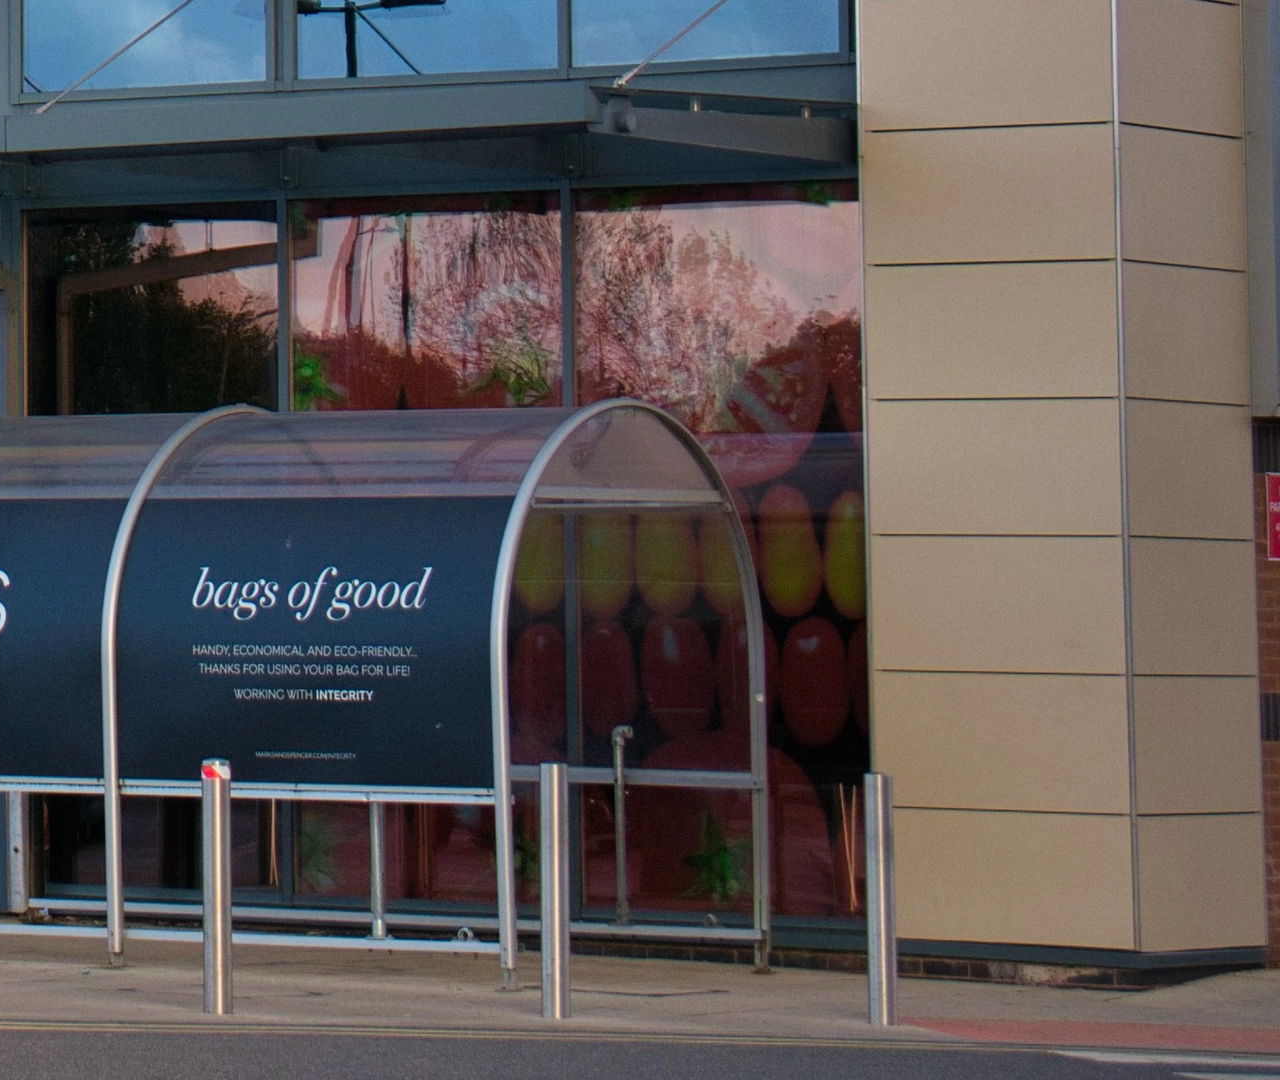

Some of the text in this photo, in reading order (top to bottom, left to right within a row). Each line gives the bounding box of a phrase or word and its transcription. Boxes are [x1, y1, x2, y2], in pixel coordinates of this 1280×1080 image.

[192, 566, 433, 620] bags of good
[192, 645, 231, 658] HANDY,
[233, 645, 304, 657] ECONOMICAL
[307, 645, 331, 657] AND
[198, 663, 411, 677] THANKS FOR USING YOUR BAG FOR LIFE!
[234, 688, 374, 701] WORKING WITH INTEGRITY
